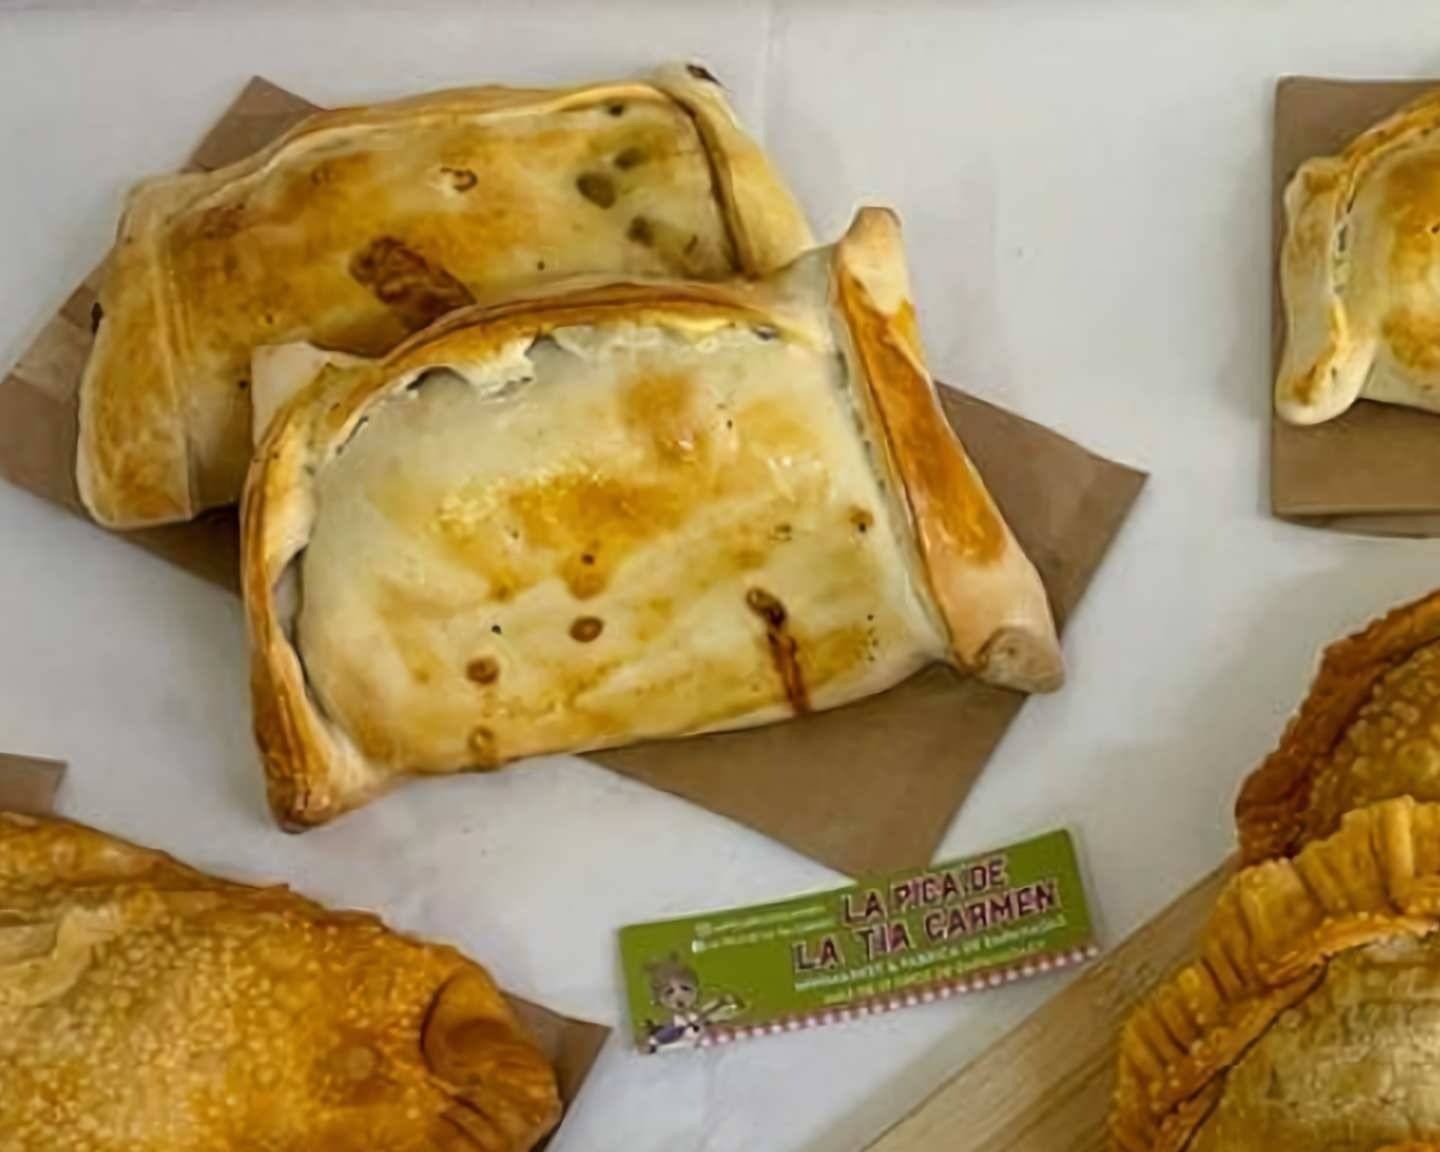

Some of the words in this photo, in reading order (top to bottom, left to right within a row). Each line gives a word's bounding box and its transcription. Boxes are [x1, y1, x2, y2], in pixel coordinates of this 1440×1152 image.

[792, 934, 845, 973] LA
[853, 918, 915, 961] TIA
[922, 877, 1063, 943] CARMEN
[840, 890, 887, 926] LA
[968, 855, 1007, 893] DE
